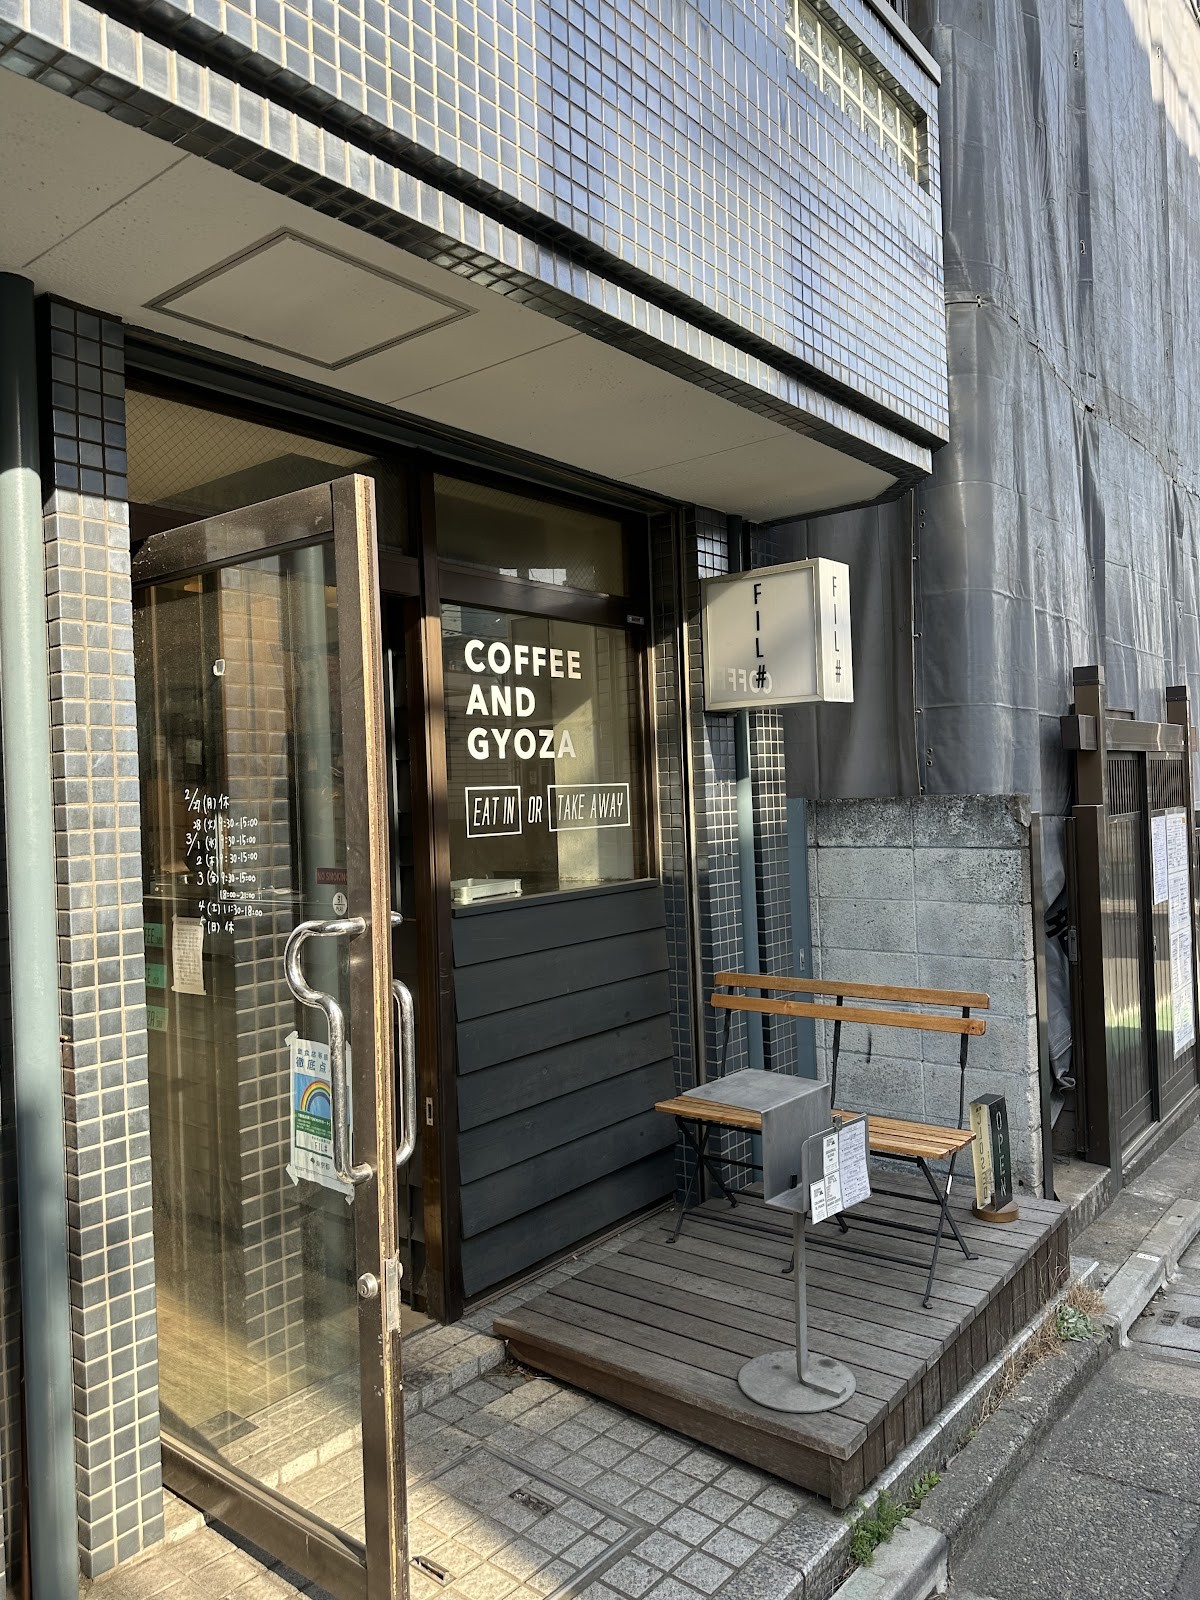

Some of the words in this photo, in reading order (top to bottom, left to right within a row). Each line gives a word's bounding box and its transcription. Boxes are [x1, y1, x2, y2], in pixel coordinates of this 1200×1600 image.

[753, 583, 767, 689] FIL#
[832, 576, 841, 683] FIL#
[464, 639, 582, 680] COFFEE
[465, 684, 536, 717] AND
[467, 727, 577, 760] GYOZA
[473, 797, 500, 827] EAT
[503, 796, 515, 824] IN
[527, 796, 543, 824] OR
[557, 793, 585, 821] TAKE
[590, 792, 624, 819] AWAY
[196, 856, 202, 866] 2
[197, 872, 204, 886] 3
[198, 900, 206, 912] 4
[996, 1111, 1007, 1197] OPEN
